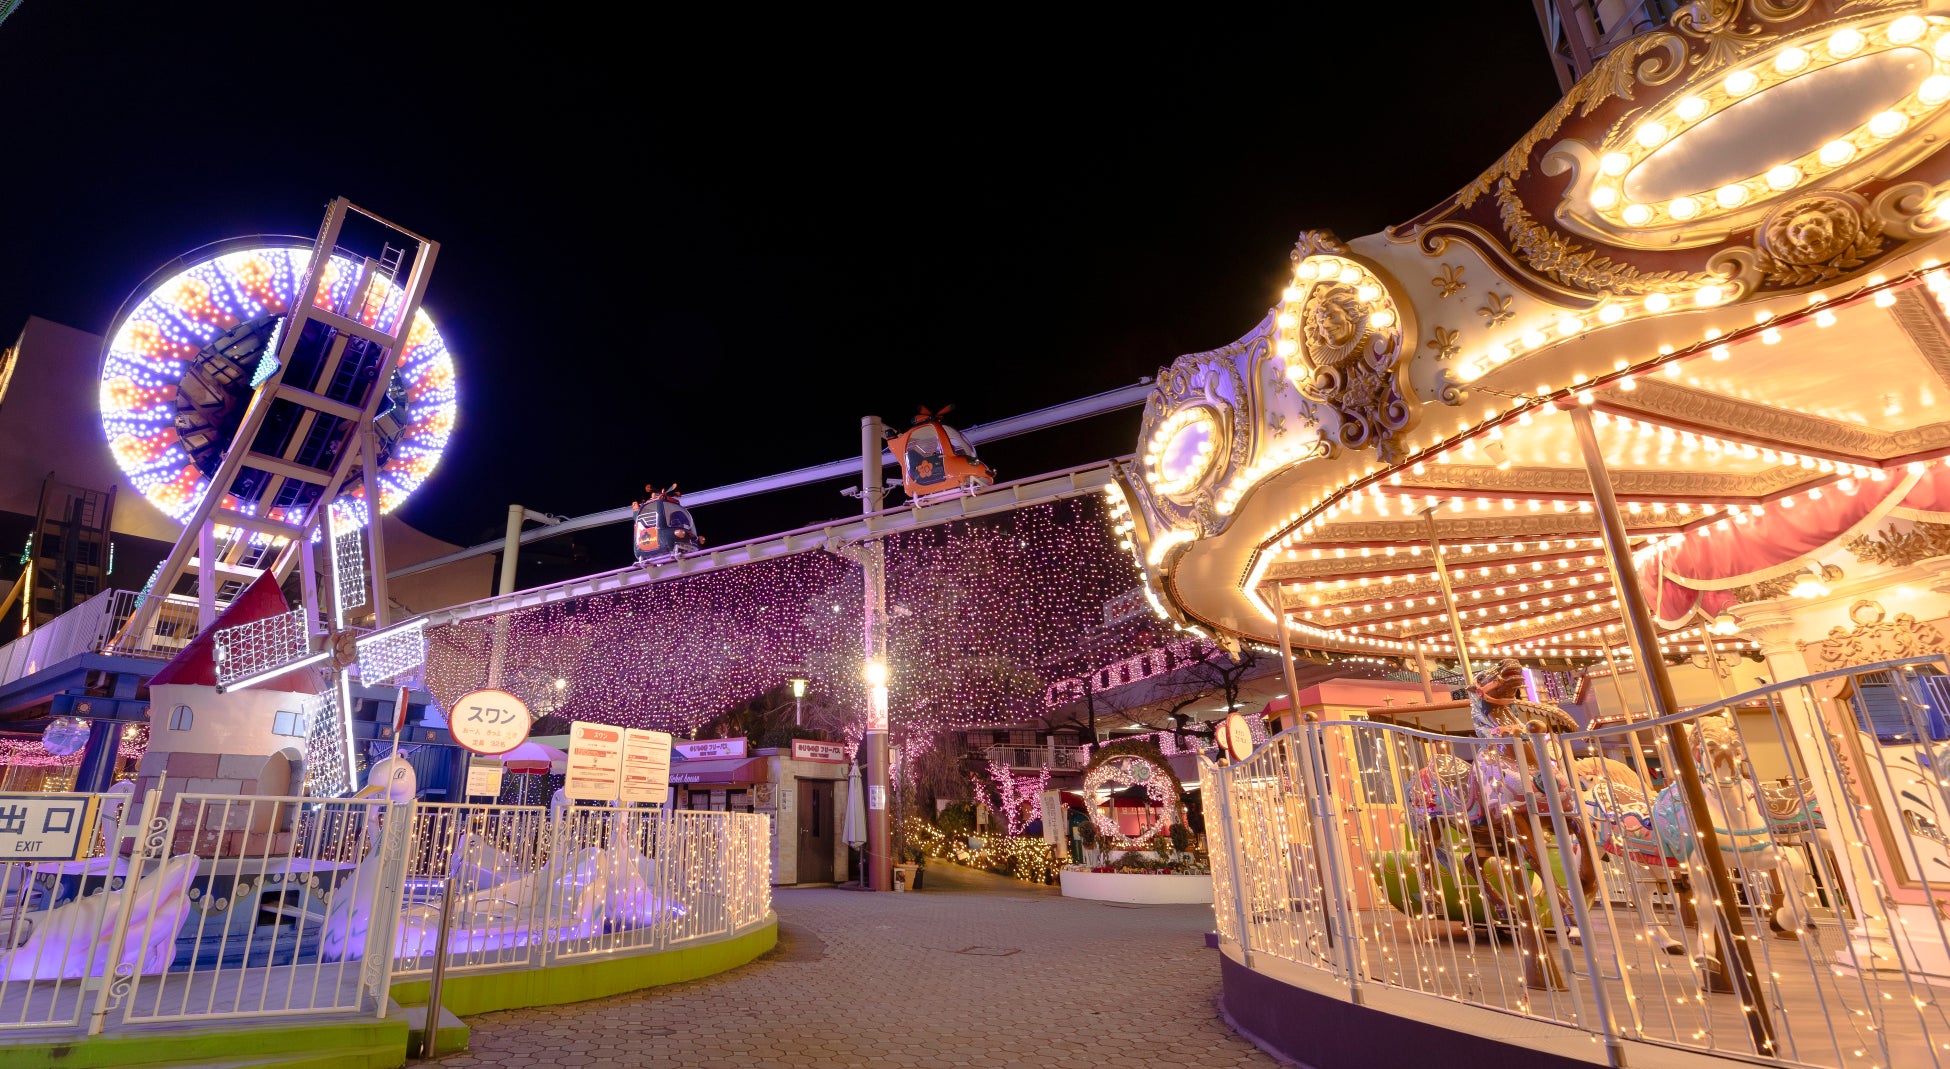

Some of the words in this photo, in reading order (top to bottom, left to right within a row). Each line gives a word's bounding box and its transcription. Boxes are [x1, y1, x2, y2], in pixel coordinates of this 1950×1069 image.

[468, 706, 516, 724] スワン
[593, 731, 608, 739] スワン
[0, 804, 75, 835] 出口
[15, 841, 43, 852] EXIT
